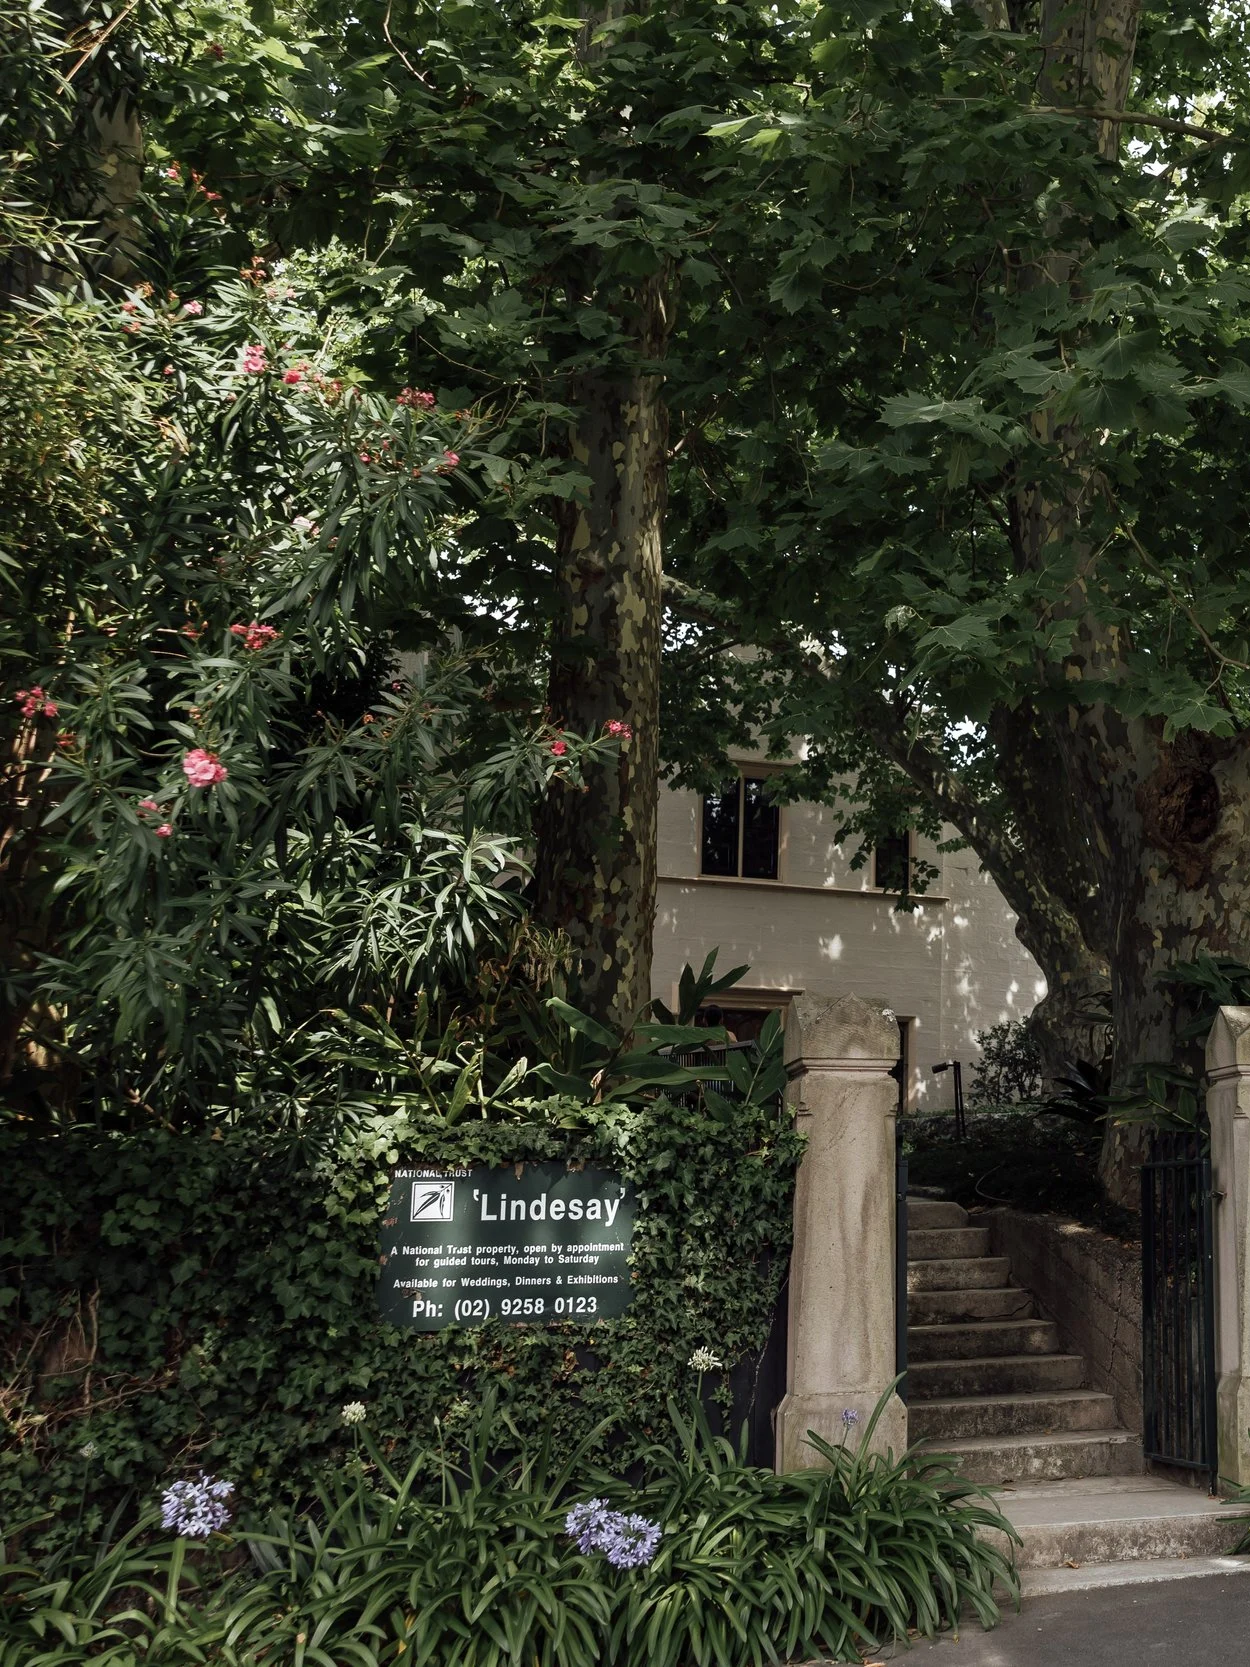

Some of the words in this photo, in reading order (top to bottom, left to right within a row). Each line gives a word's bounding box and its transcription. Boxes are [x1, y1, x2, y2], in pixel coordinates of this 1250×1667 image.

[394, 1169, 442, 1178] NATIONAL
[443, 1169, 473, 1178] TRUST
[390, 1246, 398, 1256] A
[402, 1244, 443, 1255] National
[446, 1244, 472, 1255] Trust
[476, 1243, 520, 1256] property,
[523, 1244, 547, 1255] open
[551, 1243, 563, 1254] by
[566, 1242, 624, 1254] appointment
[415, 1256, 429, 1267] for
[433, 1255, 467, 1268] guided
[470, 1255, 499, 1267] tours,
[503, 1254, 540, 1267] Monday
[544, 1255, 554, 1264] to
[558, 1254, 599, 1265] Saturday
[393, 1278, 438, 1289] Available
[442, 1277, 457, 1288] for
[460, 1276, 511, 1289] Weddings,
[515, 1276, 552, 1285] Dinners
[555, 1275, 563, 1285] &
[567, 1274, 619, 1285] Exhibitions
[412, 1300, 443, 1318] Ph:
[454, 1298, 490, 1320] (02)
[501, 1297, 545, 1316] 9258
[554, 1296, 598, 1314] 0123
